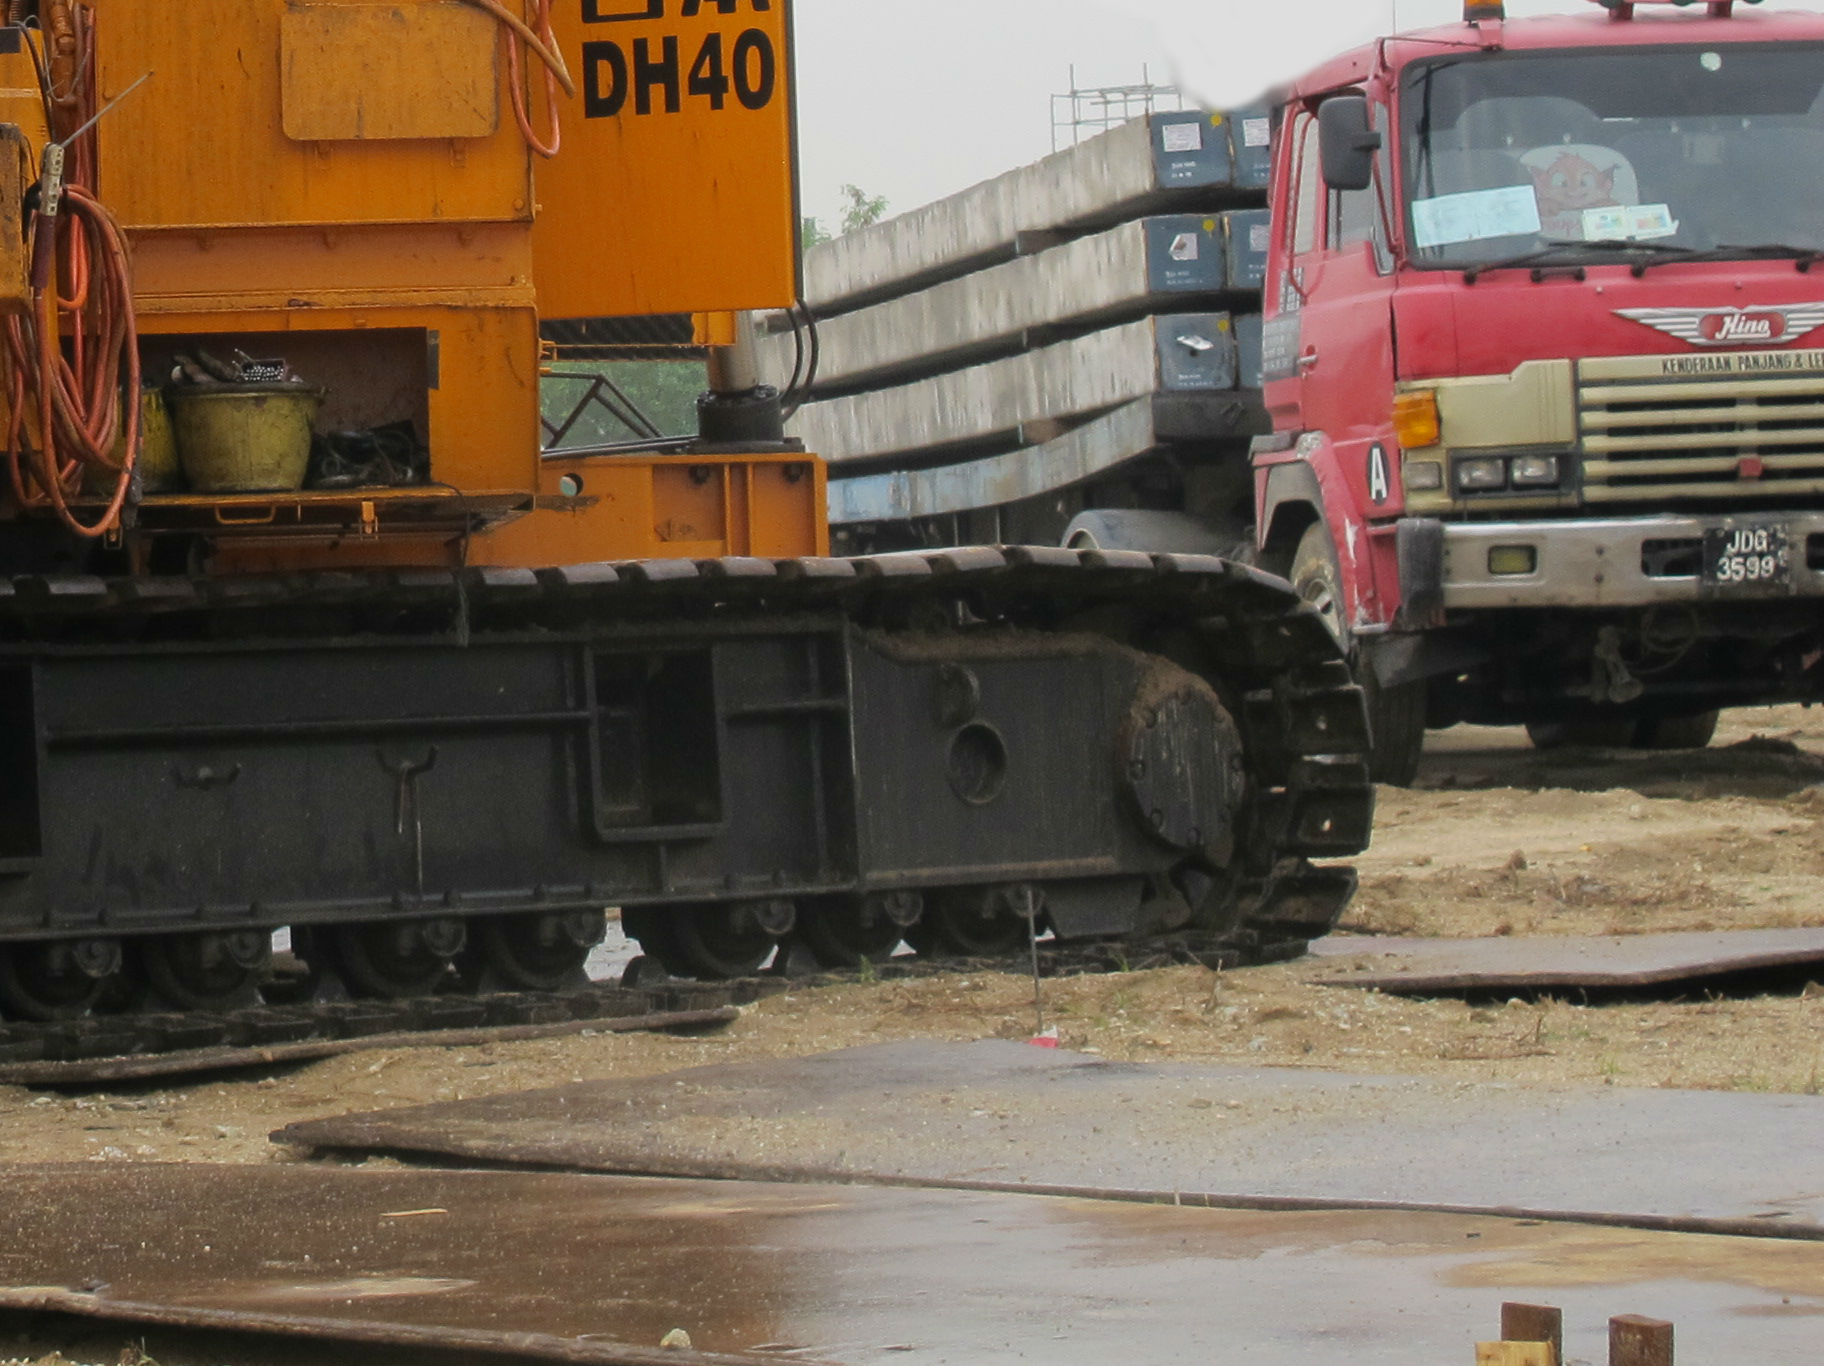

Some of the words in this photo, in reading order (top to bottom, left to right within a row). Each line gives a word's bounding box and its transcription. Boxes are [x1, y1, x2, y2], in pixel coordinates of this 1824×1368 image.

[582, 28, 776, 119] DH40
[1715, 313, 1771, 339] Hino
[1662, 355, 1732, 375] KENDERAAN
[1738, 353, 1792, 371] PANJANG
[1371, 447, 1388, 500] A
[1717, 555, 1776, 582] 3599
